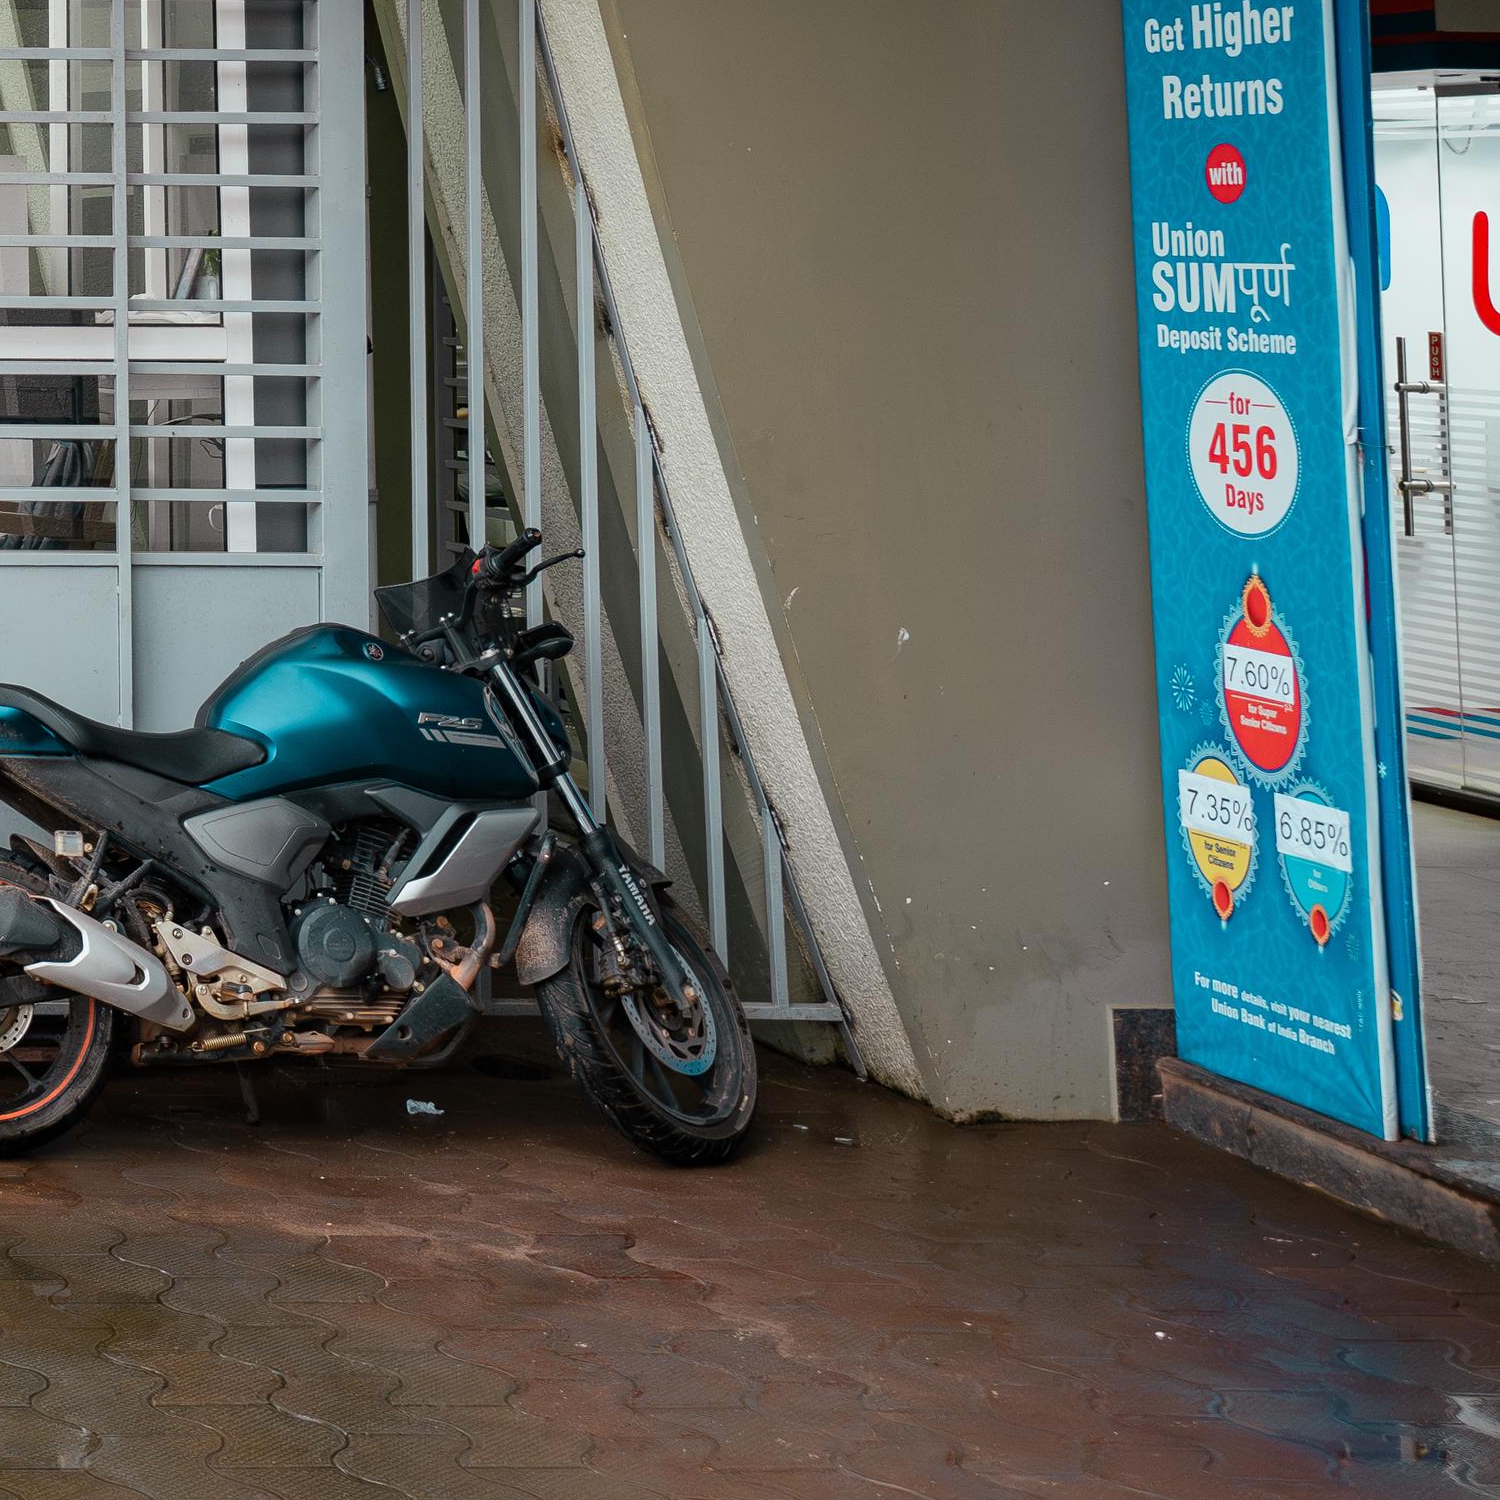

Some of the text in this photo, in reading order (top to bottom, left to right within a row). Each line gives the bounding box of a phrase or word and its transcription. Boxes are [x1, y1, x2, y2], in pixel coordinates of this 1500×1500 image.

[1144, 0, 1294, 57] Get Higher
[1162, 74, 1284, 119] Returns
[1209, 162, 1243, 185] with
[1152, 221, 1225, 257] Union
[1157, 323, 1296, 355] Deposit Scheme
[1431, 335, 1440, 376] PUSH
[1229, 391, 1251, 415] for
[1208, 422, 1277, 480] 456
[1225, 483, 1265, 515] Days
[1227, 656, 1289, 696] 7.60%
[1187, 788, 1253, 831] 7.35%
[1280, 811, 1348, 857] 6.85%
[618, 864, 655, 926] YAMAHA
[1194, 971, 1210, 989] For
[1212, 979, 1239, 998] more
[1270, 1001, 1287, 1016] visit
[1288, 1005, 1311, 1024] your
[1312, 1015, 1352, 1039] nearest
[1211, 997, 1336, 1055] Union Bank of India Branch
